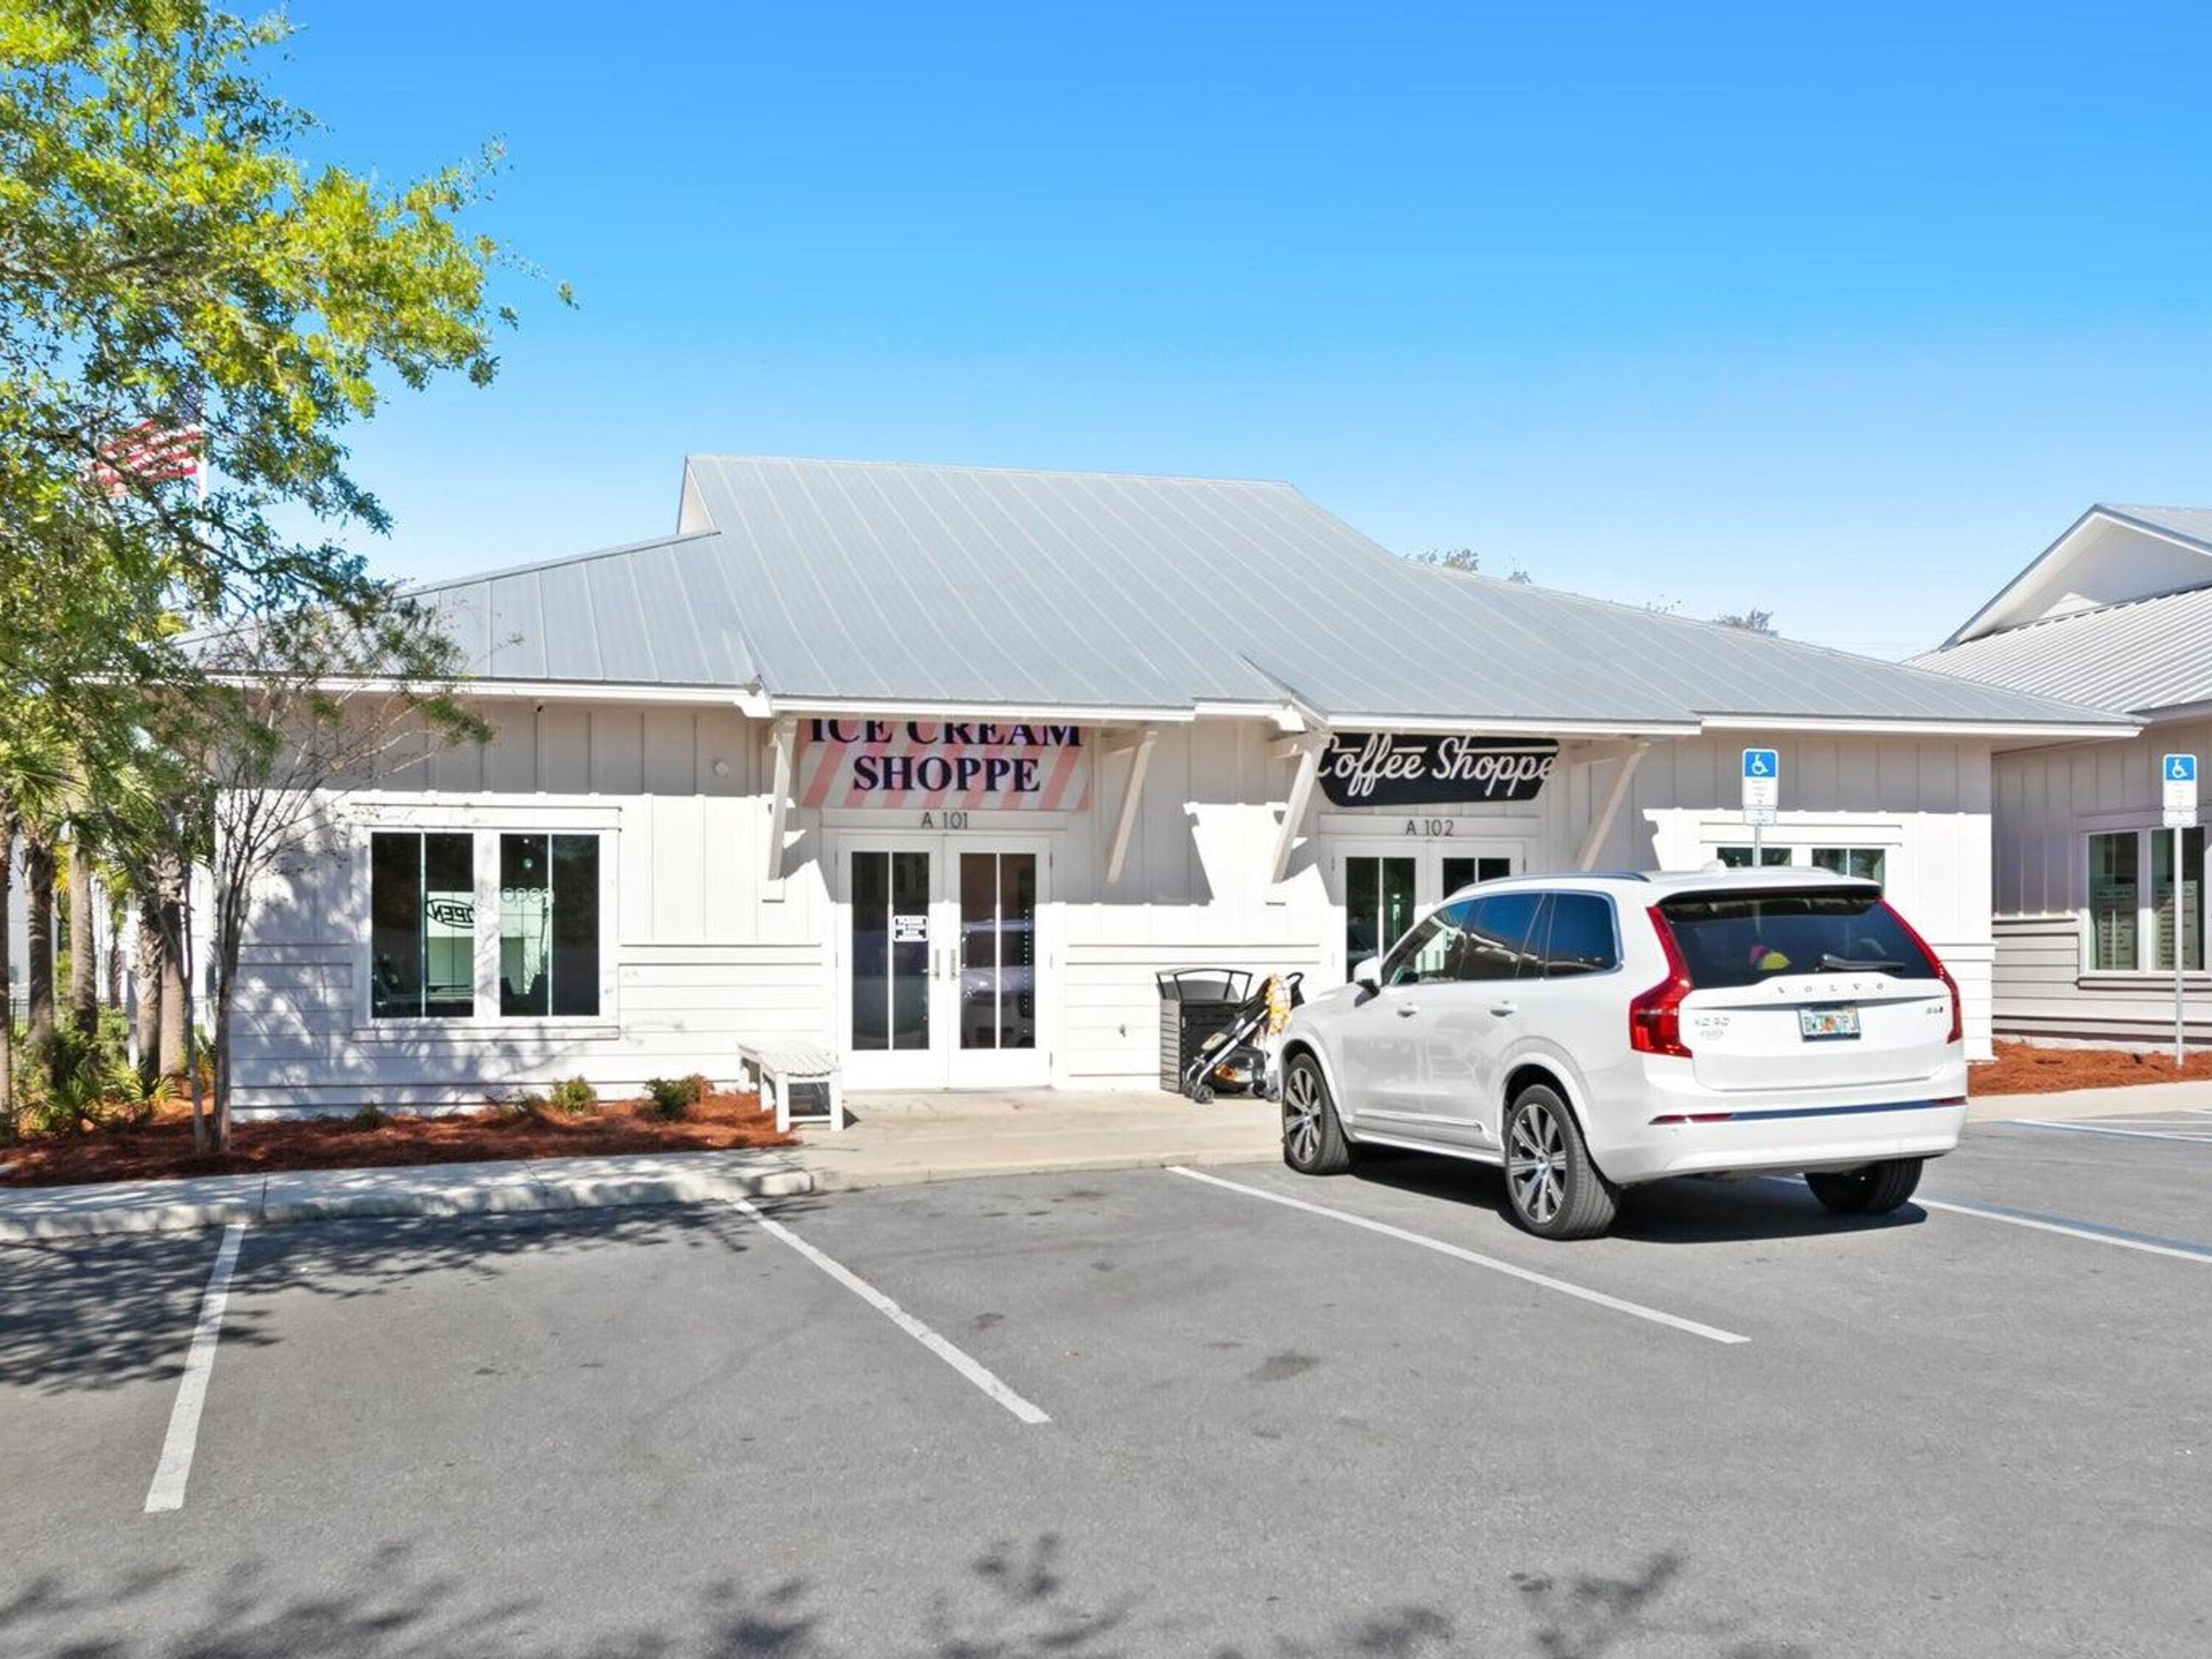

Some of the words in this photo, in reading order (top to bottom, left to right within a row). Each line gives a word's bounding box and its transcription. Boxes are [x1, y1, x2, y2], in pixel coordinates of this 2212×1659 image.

[852, 754, 1040, 793] SHOPPE
[920, 811, 934, 830] A
[943, 811, 968, 830] 101
[1405, 819, 1416, 835] A
[1425, 819, 1454, 836] 102
